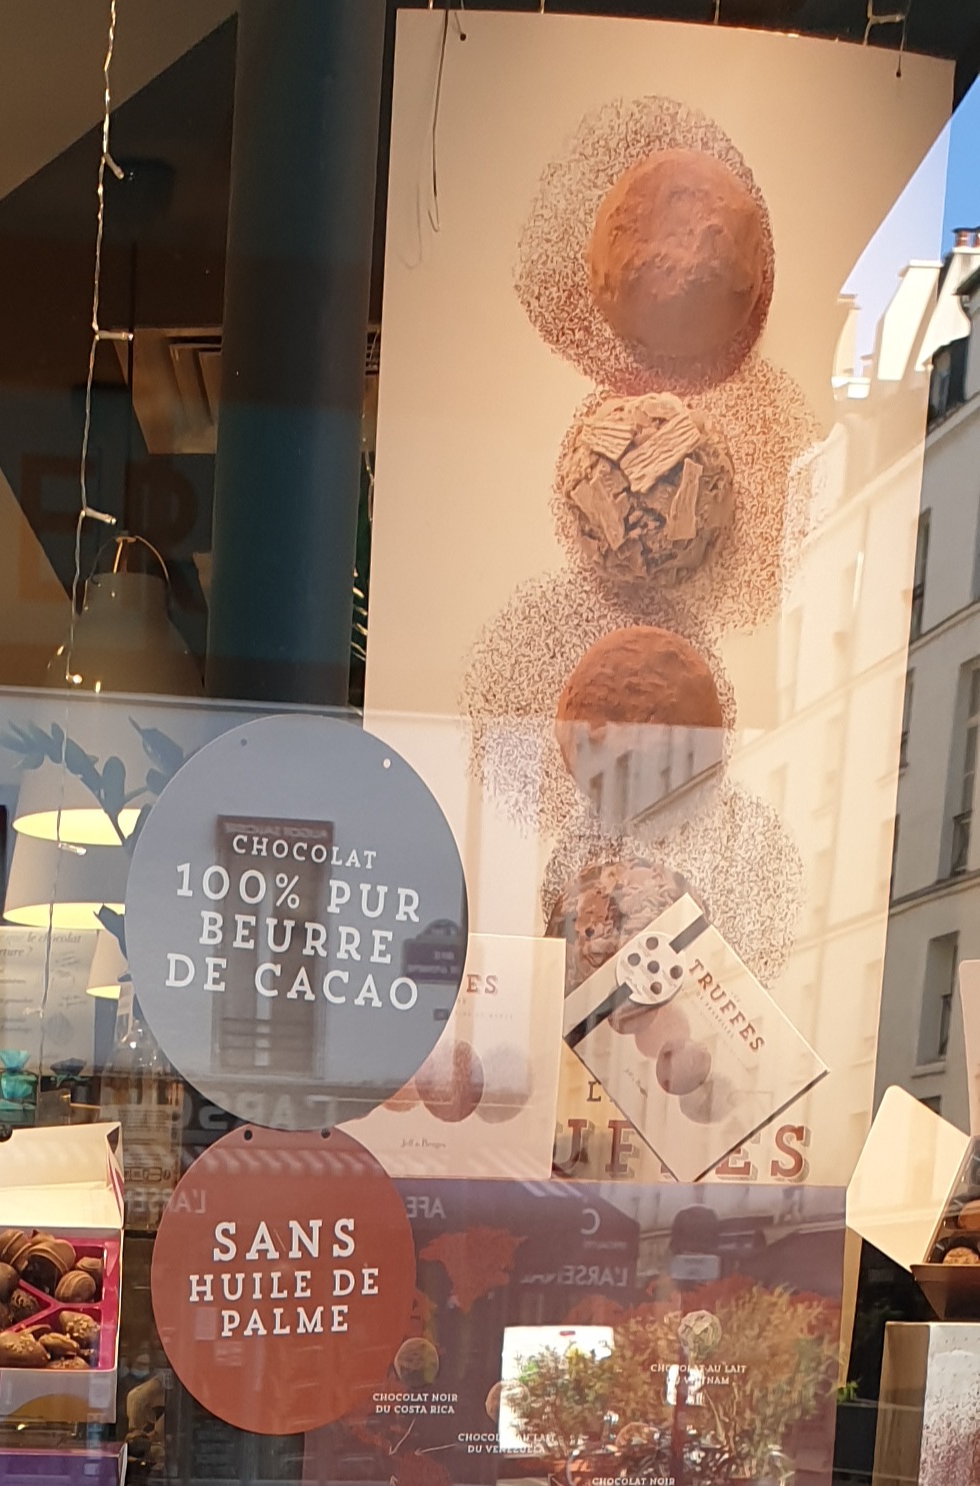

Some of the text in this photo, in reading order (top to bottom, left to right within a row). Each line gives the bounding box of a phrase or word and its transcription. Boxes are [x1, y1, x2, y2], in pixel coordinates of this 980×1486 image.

[232, 835, 377, 870] CHOCOLAT
[176, 862, 420, 923] 100% PUR
[27, 932, 37, 943] le
[199, 910, 394, 964] BEURRE
[165, 953, 227, 992] DE
[254, 963, 419, 1011] CACAO
[689, 959, 765, 1053] TRUFFES
[213, 1217, 357, 1262] SANS
[189, 1267, 380, 1302] HUILE DE
[221, 1305, 349, 1337] PALME
[725, 1364, 747, 1374] LAIT
[373, 1393, 458, 1402] CHOCOLAT NOIR
[375, 1405, 455, 1414] DU COSTA RICA
[467, 1445, 482, 1453] DU
[592, 1477, 675, 1486] CHOCOLAT NOIR
